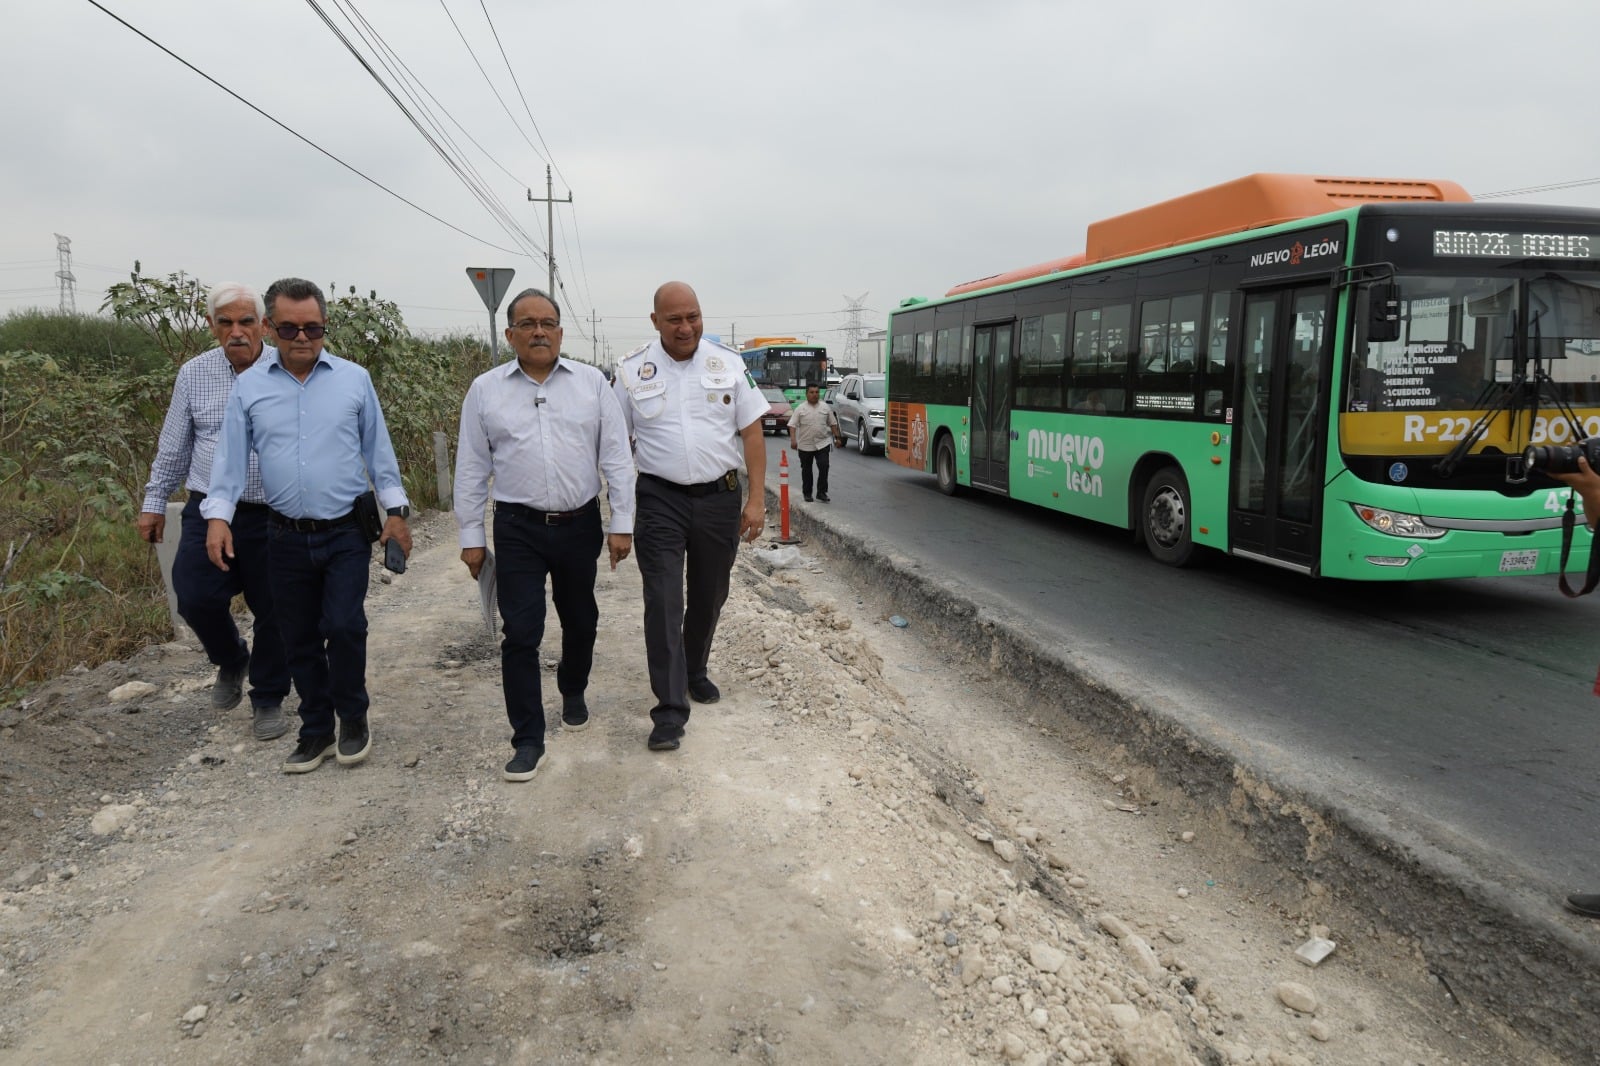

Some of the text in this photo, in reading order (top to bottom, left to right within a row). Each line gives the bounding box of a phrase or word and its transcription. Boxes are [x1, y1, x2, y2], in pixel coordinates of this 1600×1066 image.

[1436, 231, 1478, 254] RUTA
[1481, 232, 1510, 255] 226
[1523, 233, 1590, 257] BOSQUES
[1250, 237, 1339, 267] NUEVO LEÓN
[1413, 356, 1427, 364] DEL
[1428, 355, 1458, 364] CARMEN
[1386, 366, 1434, 376] BUENA VISTA
[1395, 398, 1437, 407] AUTOBUSES
